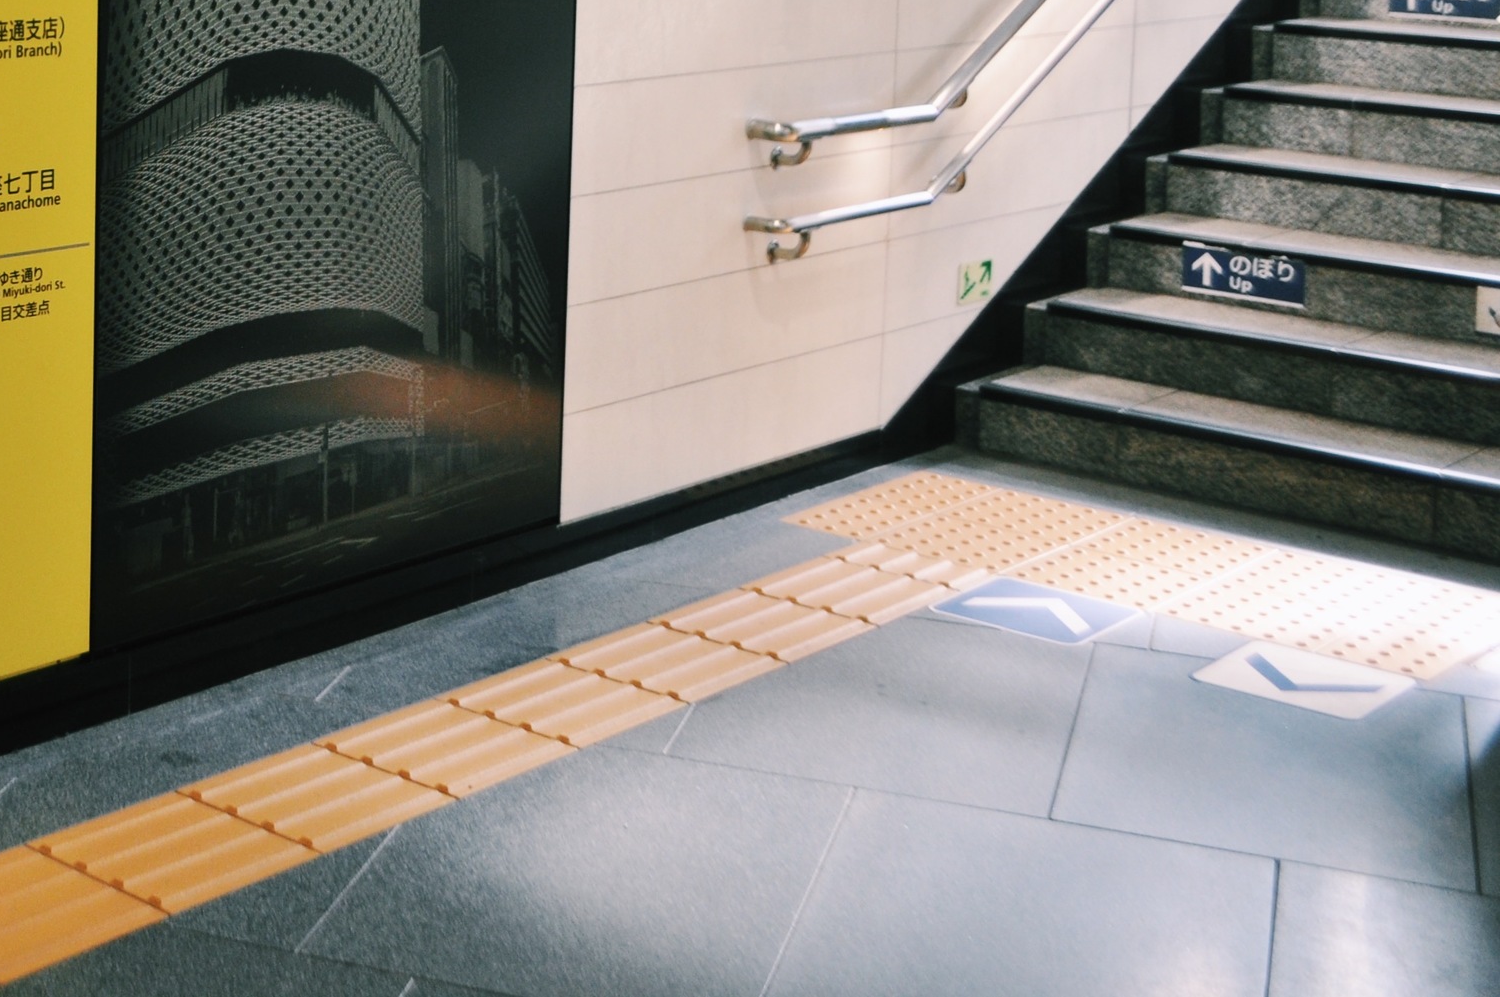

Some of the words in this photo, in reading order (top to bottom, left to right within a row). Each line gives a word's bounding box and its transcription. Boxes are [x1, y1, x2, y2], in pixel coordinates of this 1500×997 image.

[16, 41, 62, 60] Branch)
[1229, 255, 1295, 283] のぼり
[3, 282, 52, 299] Miyuki-dori
[55, 279, 66, 290] St.
[1229, 275, 1253, 294] Up
